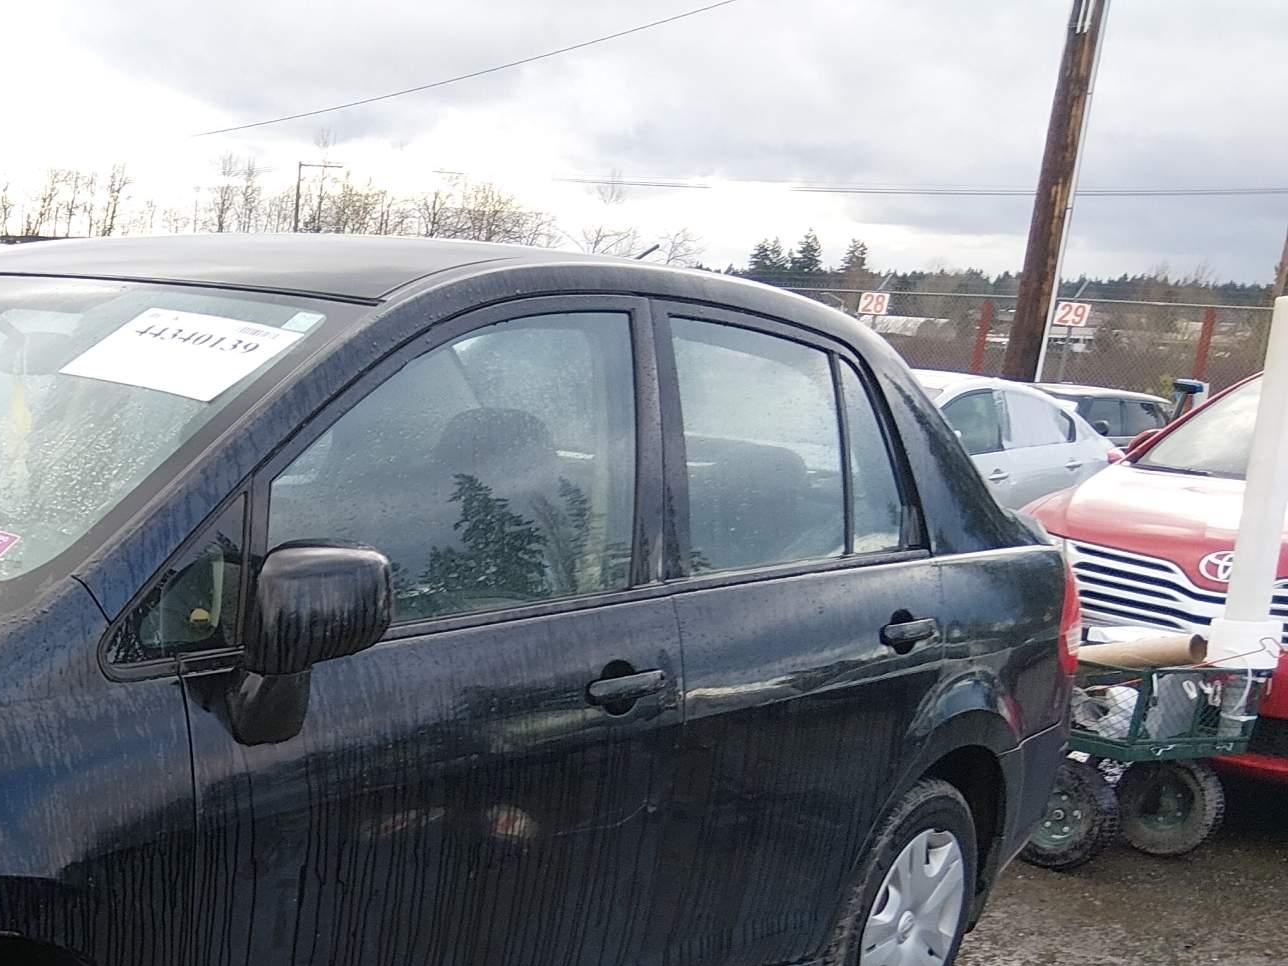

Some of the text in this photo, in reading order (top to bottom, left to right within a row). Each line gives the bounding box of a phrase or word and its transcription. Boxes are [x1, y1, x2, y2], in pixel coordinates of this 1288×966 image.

[862, 294, 886, 313] 28
[1057, 303, 1087, 325] 29
[135, 324, 261, 354] 44340139
